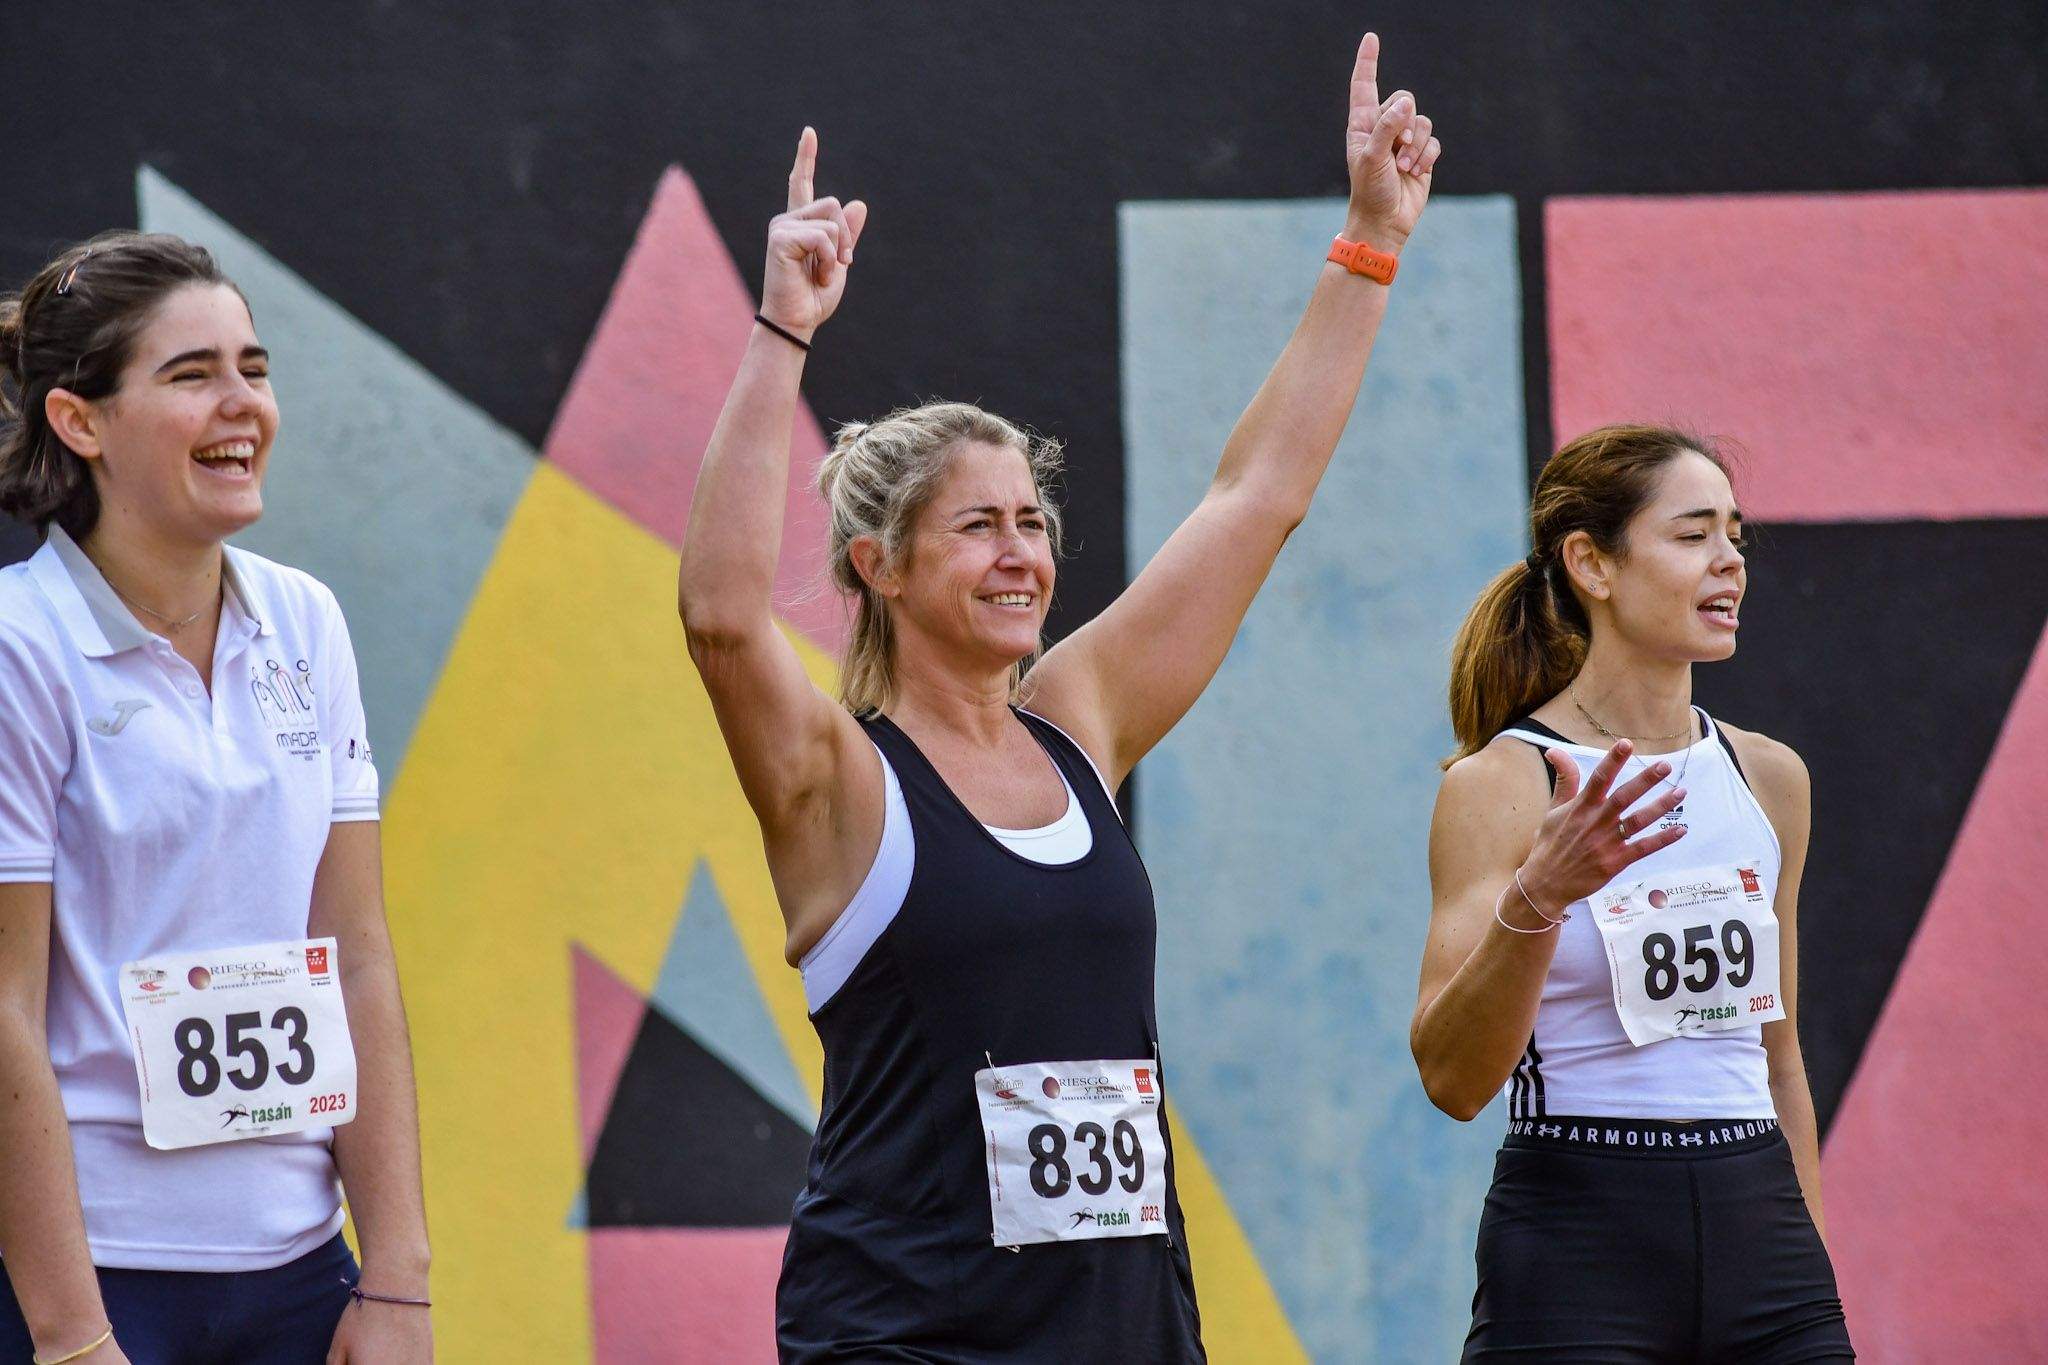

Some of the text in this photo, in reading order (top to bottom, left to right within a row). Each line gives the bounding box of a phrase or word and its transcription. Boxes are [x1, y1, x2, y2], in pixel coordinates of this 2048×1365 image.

[276, 731, 320, 747] MADR
[1666, 882, 1711, 897] RIESGO
[1700, 884, 1738, 900] gestión
[210, 961, 266, 976] RIESGO
[1642, 919, 1755, 1001] 859
[241, 966, 300, 982] y gestión
[1700, 1003, 1737, 1021] rasán
[1749, 994, 1775, 1012] 2023
[174, 1006, 315, 1097] 853
[1059, 1076, 1109, 1088] RIESGO
[1084, 1083, 1132, 1096] y gestión
[310, 1093, 346, 1114] 2023
[251, 1102, 292, 1124] rasán
[1505, 1119, 1774, 1147] OUR ARMOUR ARMOUR
[1028, 1119, 1145, 1199] 839
[1097, 1208, 1130, 1227] rasán
[1140, 1205, 1160, 1223] 2023
